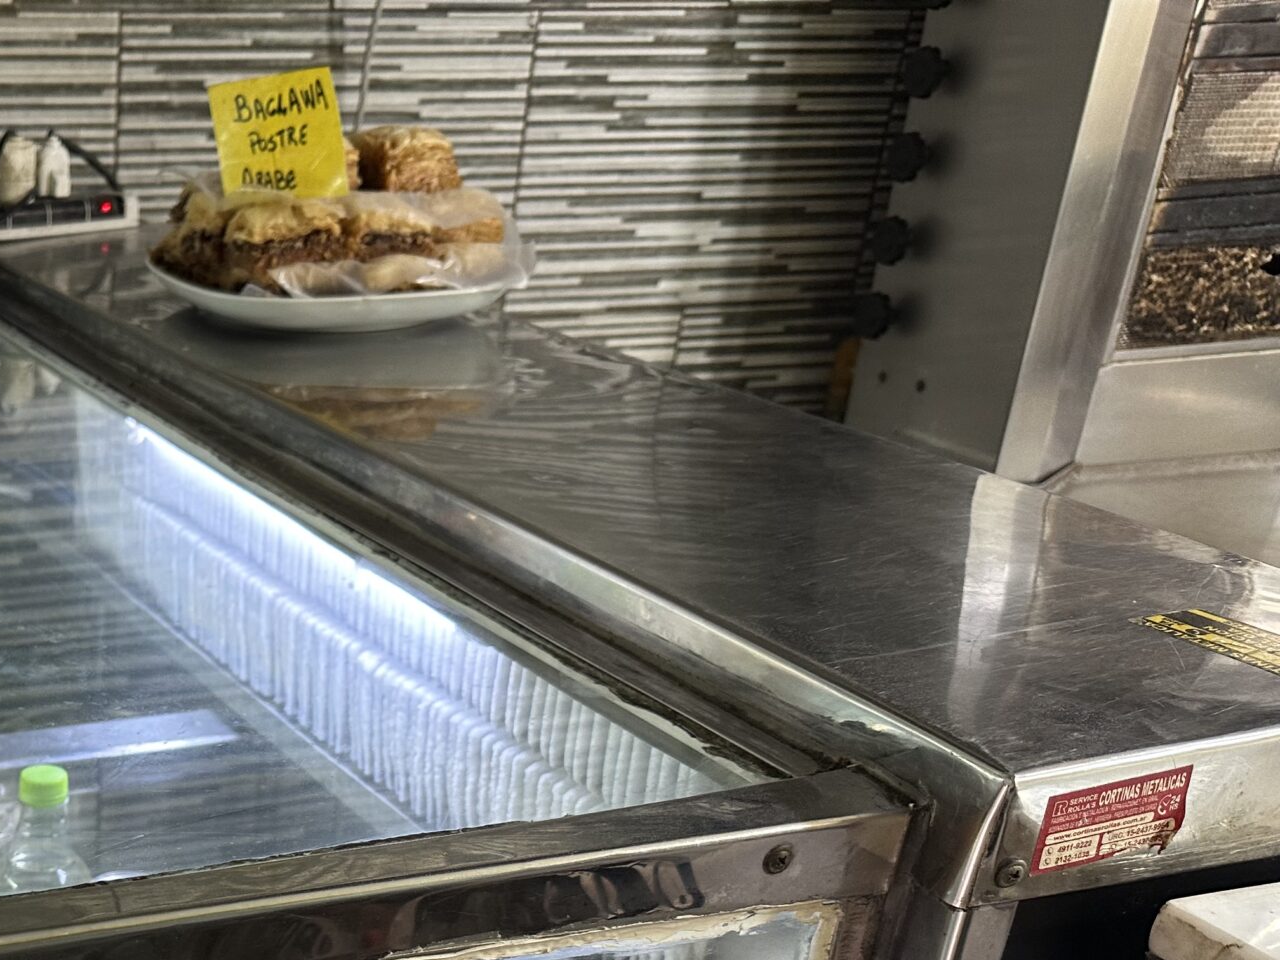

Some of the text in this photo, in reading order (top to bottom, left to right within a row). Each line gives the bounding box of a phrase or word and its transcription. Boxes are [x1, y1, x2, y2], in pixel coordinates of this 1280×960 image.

[248, 123, 308, 154] POSTRE
[1099, 772, 1187, 806] CORTINAS METALICAS
[1070, 794, 1098, 806] SERVICE
[1170, 795, 1181, 805] 24
